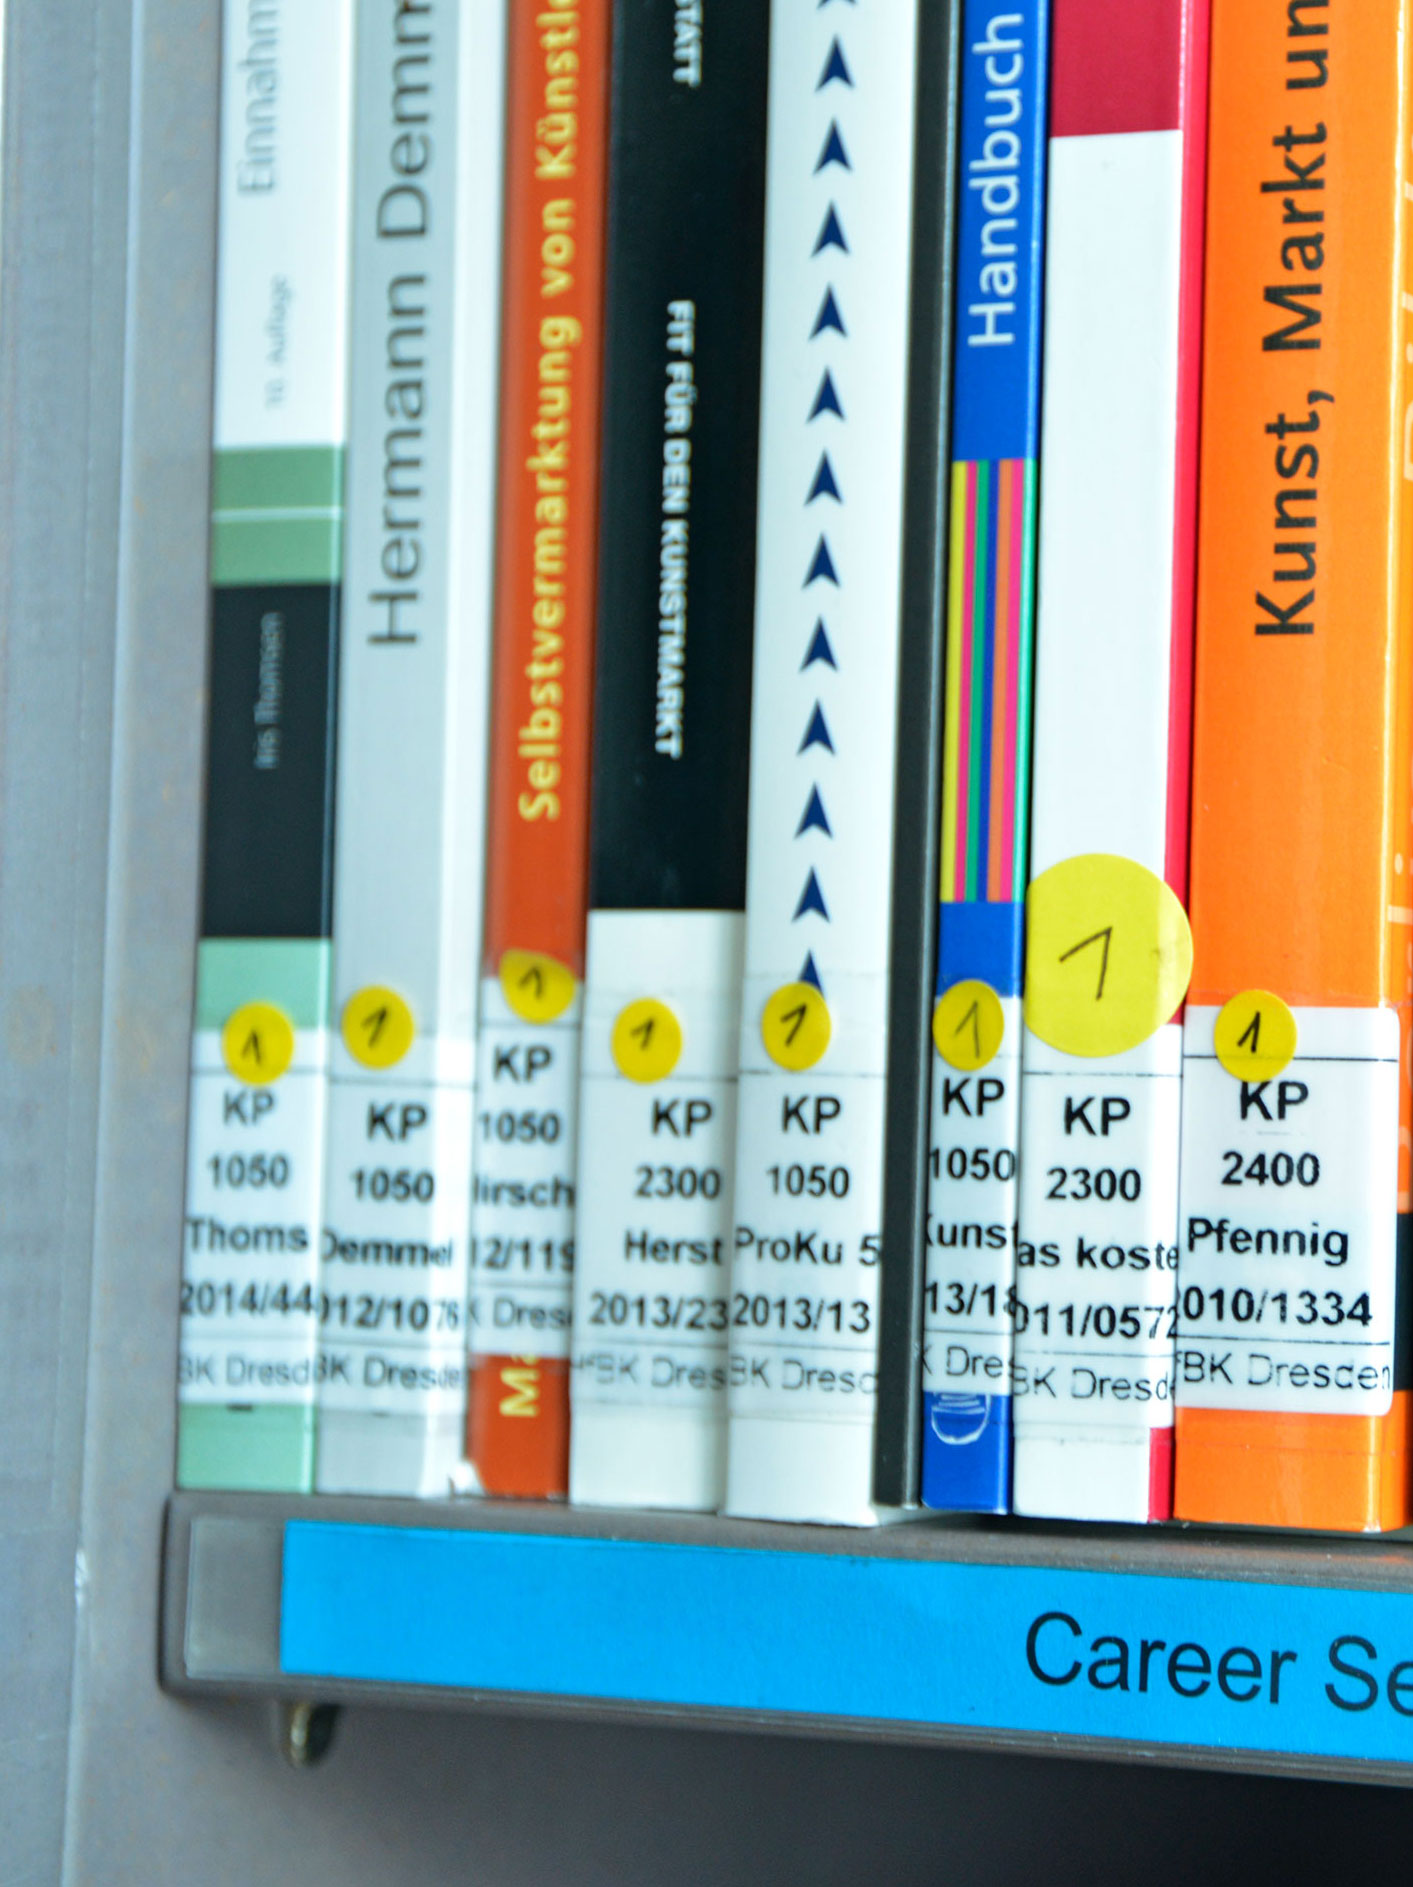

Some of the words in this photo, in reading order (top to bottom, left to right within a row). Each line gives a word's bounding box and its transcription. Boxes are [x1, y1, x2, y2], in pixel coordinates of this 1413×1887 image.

[967, 11, 1024, 348] Handbuch
[540, 198, 576, 299] von
[1260, 121, 1327, 352] Markt
[667, 299, 696, 357] FIT
[664, 361, 698, 434] FÜR
[367, 273, 428, 647] Hermann
[662, 437, 692, 514] DEN
[1254, 387, 1335, 636] Kunst,
[518, 315, 582, 822] Selbstvermarktung
[655, 518, 689, 760] KUNSTMARKT
[517, 966, 545, 1000] 1
[1058, 926, 1112, 1002] 1
[361, 1006, 388, 1048] 1
[630, 1017, 656, 1051] 1
[780, 1002, 808, 1048] 1
[955, 1000, 980, 1060] 1
[1237, 1010, 1260, 1054] 1
[240, 1030, 262, 1066] 1
[494, 1046, 552, 1083] KP
[221, 1091, 275, 1126] KP
[781, 1096, 842, 1134] KP
[942, 1077, 1006, 1117] KP
[1239, 1080, 1310, 1121] KP
[366, 1103, 428, 1141] KP
[479, 1109, 561, 1144] 1050
[651, 1099, 713, 1138] KP
[1063, 1097, 1132, 1137] KP
[208, 1153, 290, 1189] 1050
[634, 1164, 722, 1200] 2300
[766, 1164, 851, 1199] 1050
[928, 1147, 1016, 1181] 1050
[1220, 1150, 1321, 1188] 2400
[350, 1171, 435, 1202] 1050
[1045, 1167, 1142, 1202] 2300
[185, 1216, 309, 1252] Thoms
[623, 1228, 724, 1266] Herst
[734, 1226, 843, 1265] ProKu
[1187, 1216, 1350, 1268] Pfennig
[180, 1281, 313, 1317] 2014/44
[494, 1291, 572, 1330] Dres
[588, 1291, 729, 1331] 2013/23
[732, 1292, 871, 1333] 2013/13
[1177, 1285, 1373, 1327] 010/1334
[1070, 1367, 1176, 1401] Dresd
[1248, 1353, 1391, 1391] Dresden
[1024, 1610, 1298, 1707] Career
